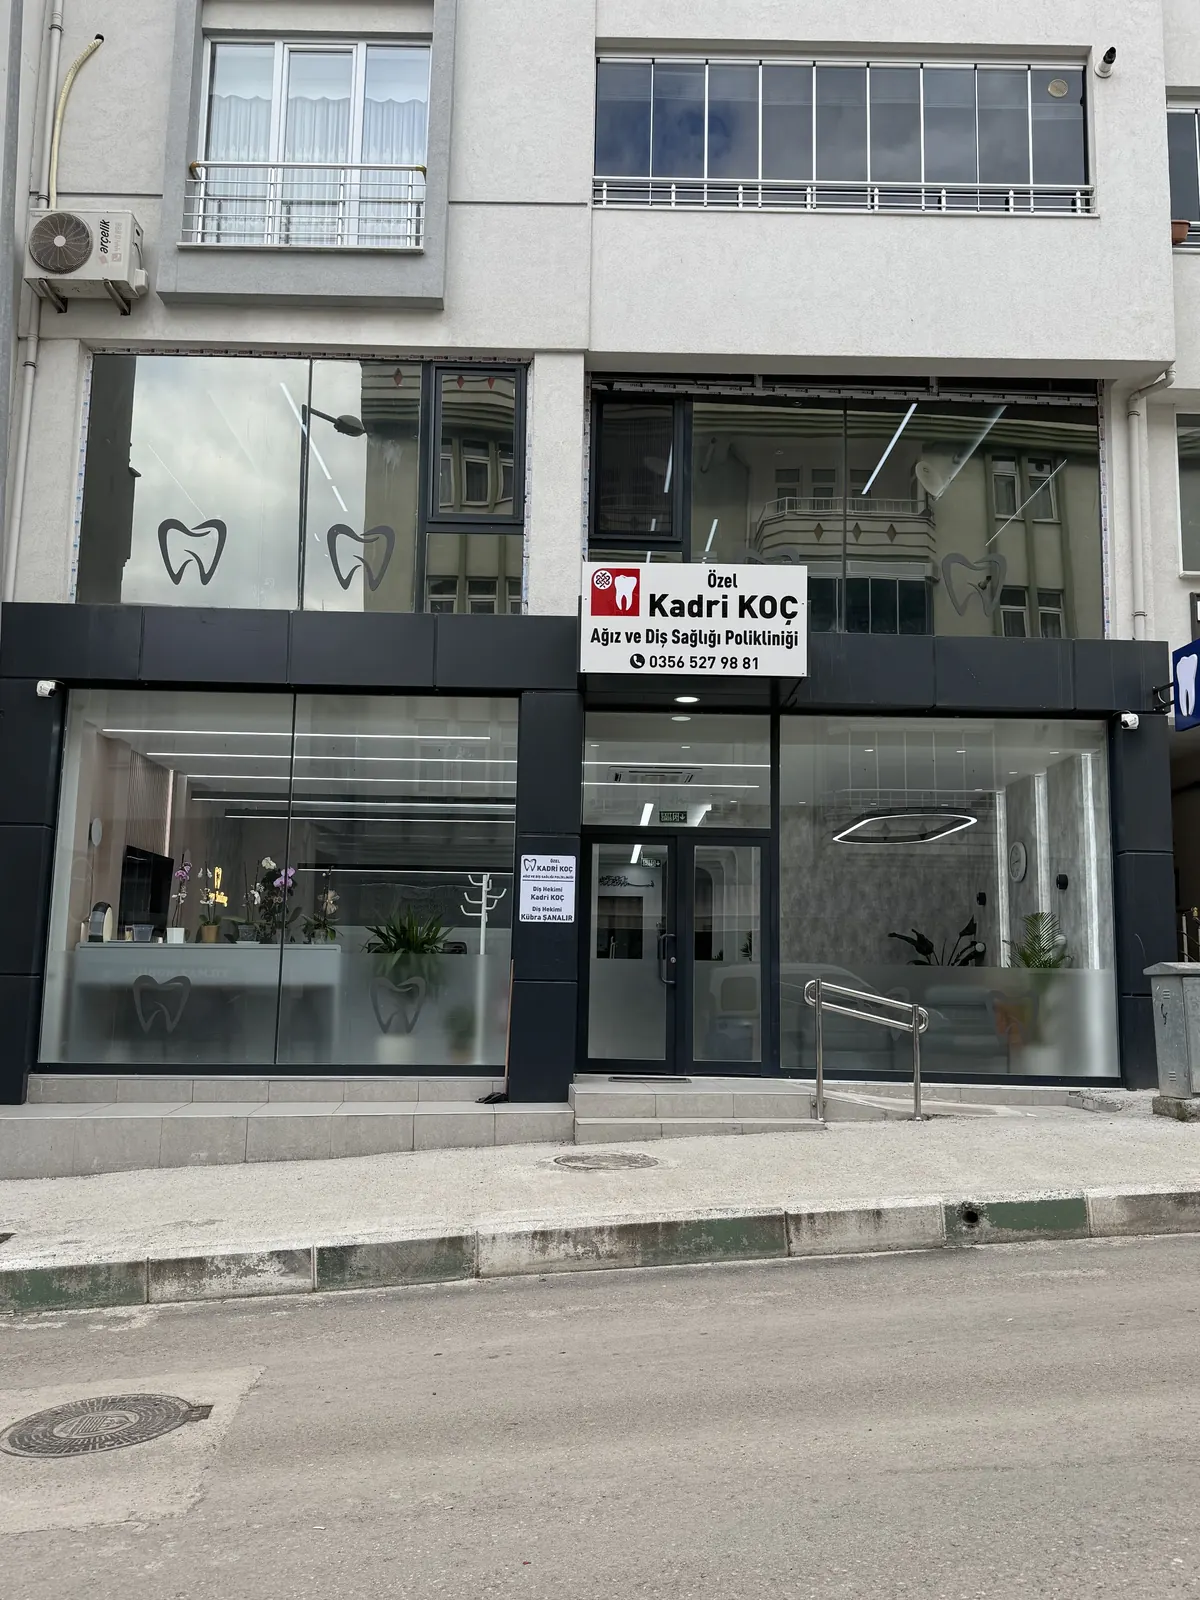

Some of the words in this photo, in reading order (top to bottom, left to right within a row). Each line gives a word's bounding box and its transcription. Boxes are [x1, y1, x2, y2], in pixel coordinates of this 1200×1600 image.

[99, 219, 111, 254] arçelik
[708, 570, 738, 588] Özel
[649, 594, 728, 618] Kadri
[738, 595, 798, 625] KOÇ
[590, 628, 621, 646] Ağız
[625, 632, 641, 644] ve
[645, 629, 668, 648] Diş
[671, 629, 721, 648] Sağlığı
[725, 630, 798, 649] Polikliniği
[649, 656, 685, 668] 0356
[689, 656, 716, 669] 527
[722, 656, 738, 669] 98
[742, 657, 759, 669] 81
[550, 894, 564, 902] KOÇ
[542, 914, 573, 922] ŞANALIR
